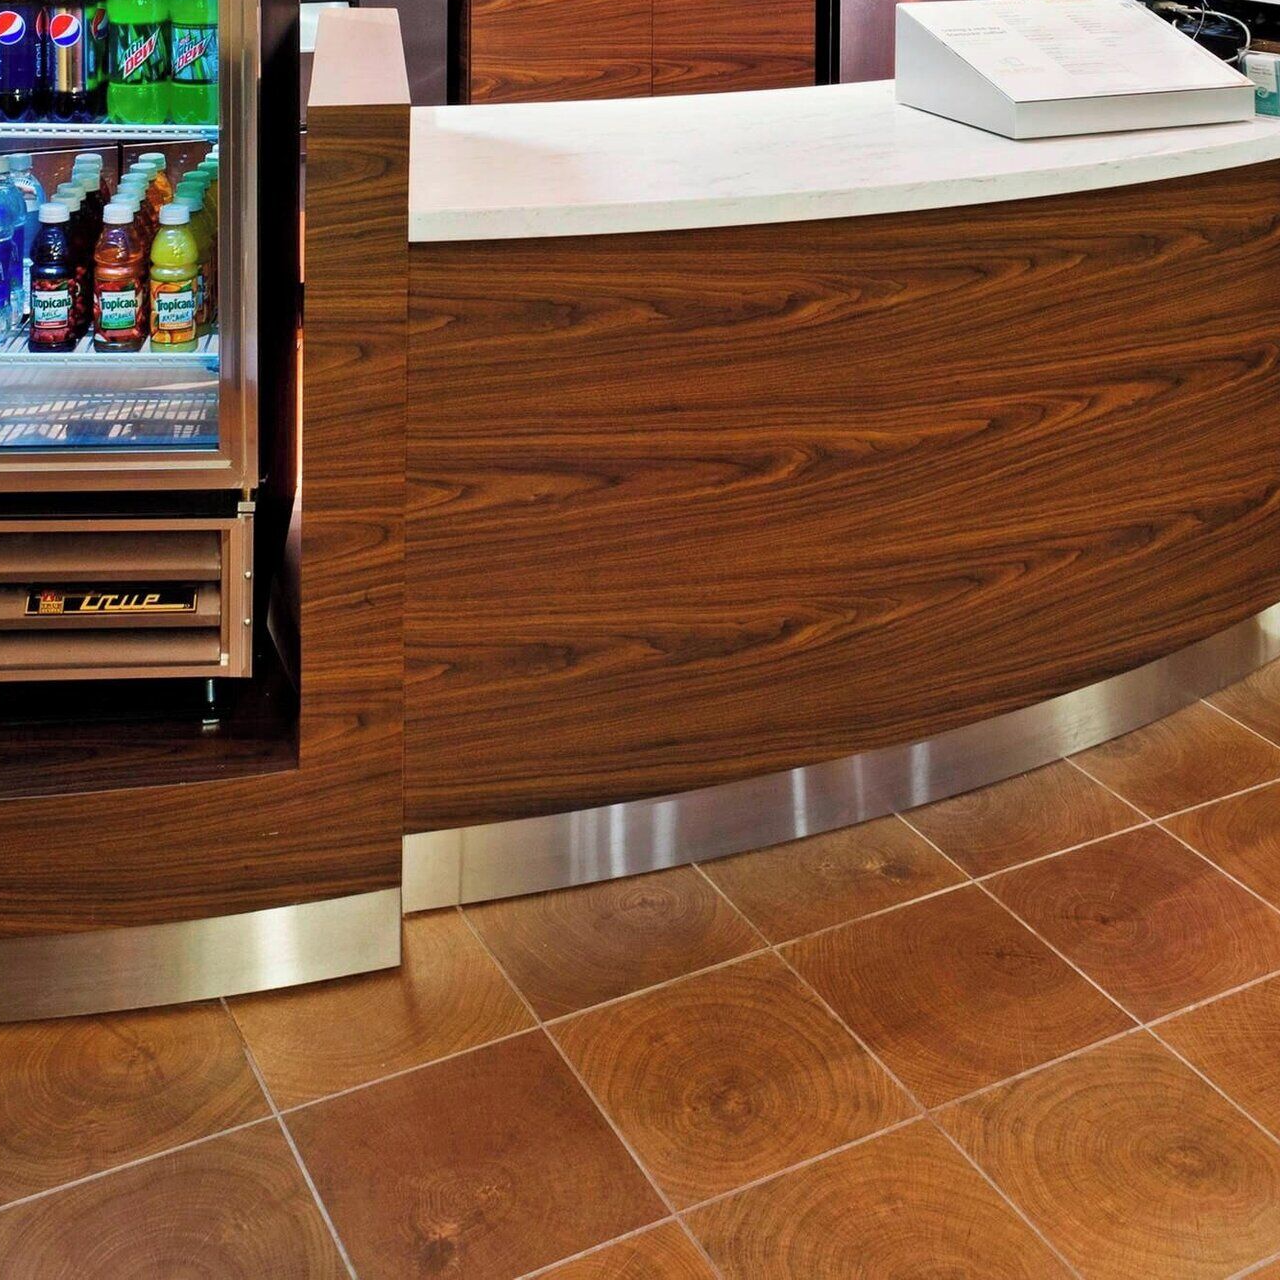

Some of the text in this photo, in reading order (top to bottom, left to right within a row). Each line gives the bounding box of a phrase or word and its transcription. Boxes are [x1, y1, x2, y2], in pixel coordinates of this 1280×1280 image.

[33, 296, 72, 312] Tropicana
[101, 296, 138, 312] Tropicana
[156, 297, 195, 312] Tropicana
